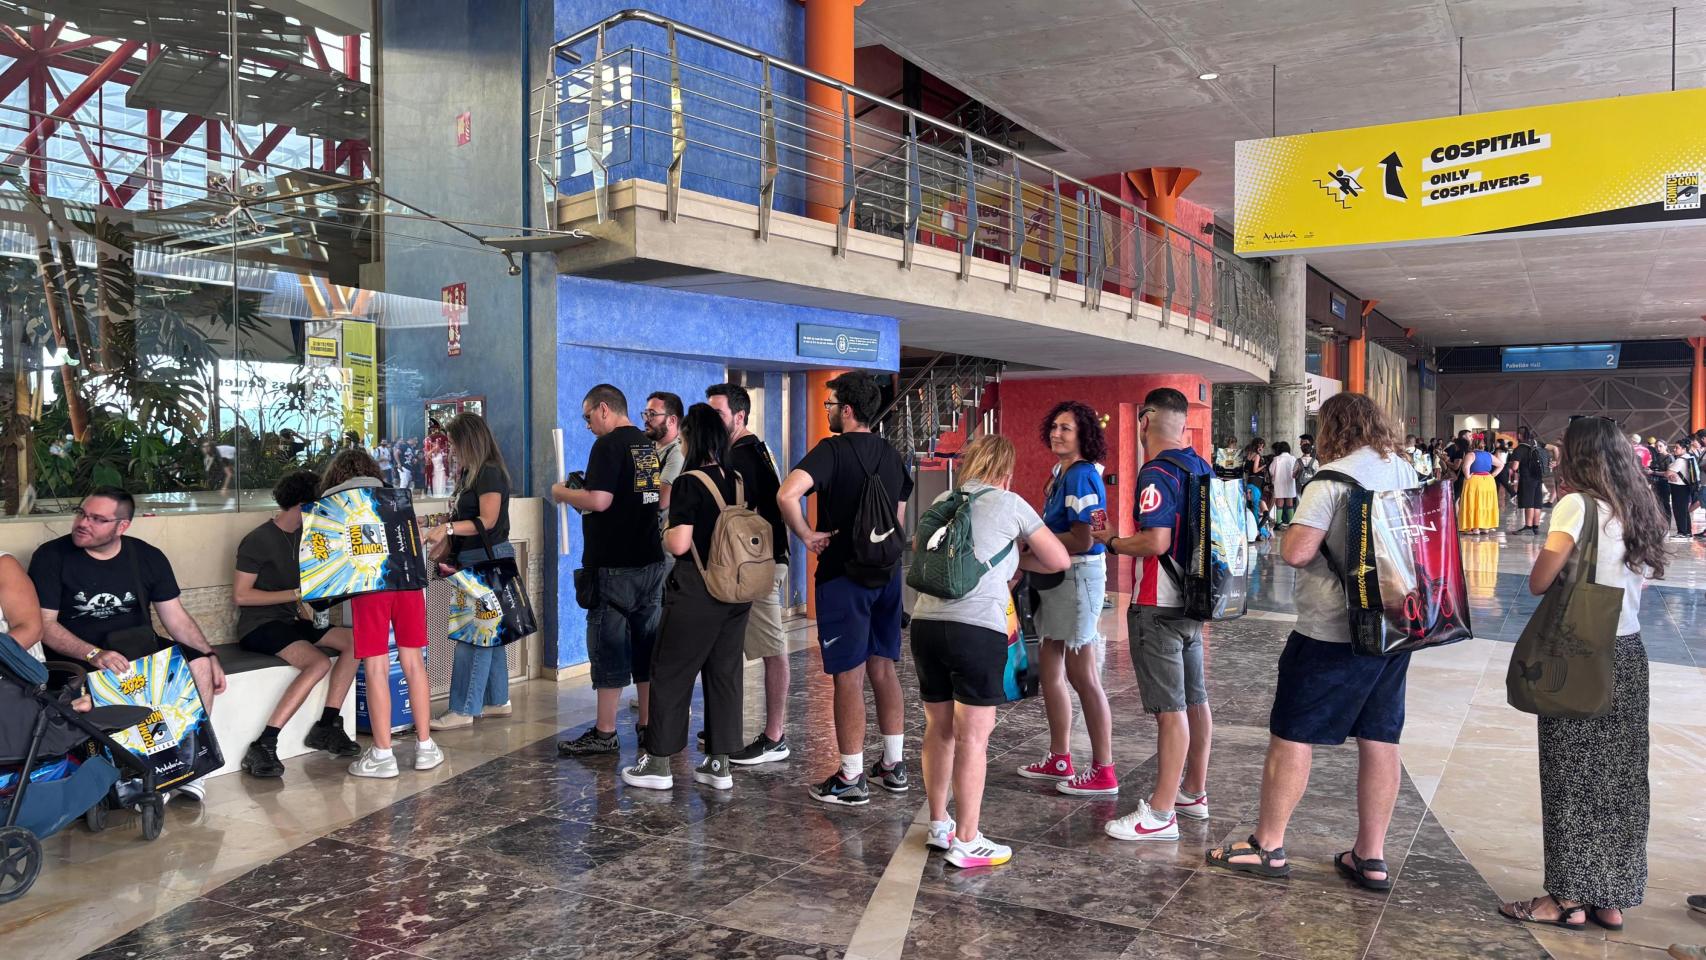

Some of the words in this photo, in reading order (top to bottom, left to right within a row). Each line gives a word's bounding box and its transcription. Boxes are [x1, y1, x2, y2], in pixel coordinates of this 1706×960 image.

[1430, 129, 1541, 164] COSPITAL
[1430, 168, 1470, 185] ONLY
[1430, 173, 1530, 201] COSPLAYERS
[1667, 178, 1678, 205] COMIC
[1677, 175, 1698, 186] CON
[1606, 354, 1615, 366] 2
[349, 525, 362, 544] CON
[312, 533, 330, 561] 2025
[352, 543, 384, 556] COMIC
[121, 674, 146, 695] 2025
[137, 721, 155, 749] COMI
